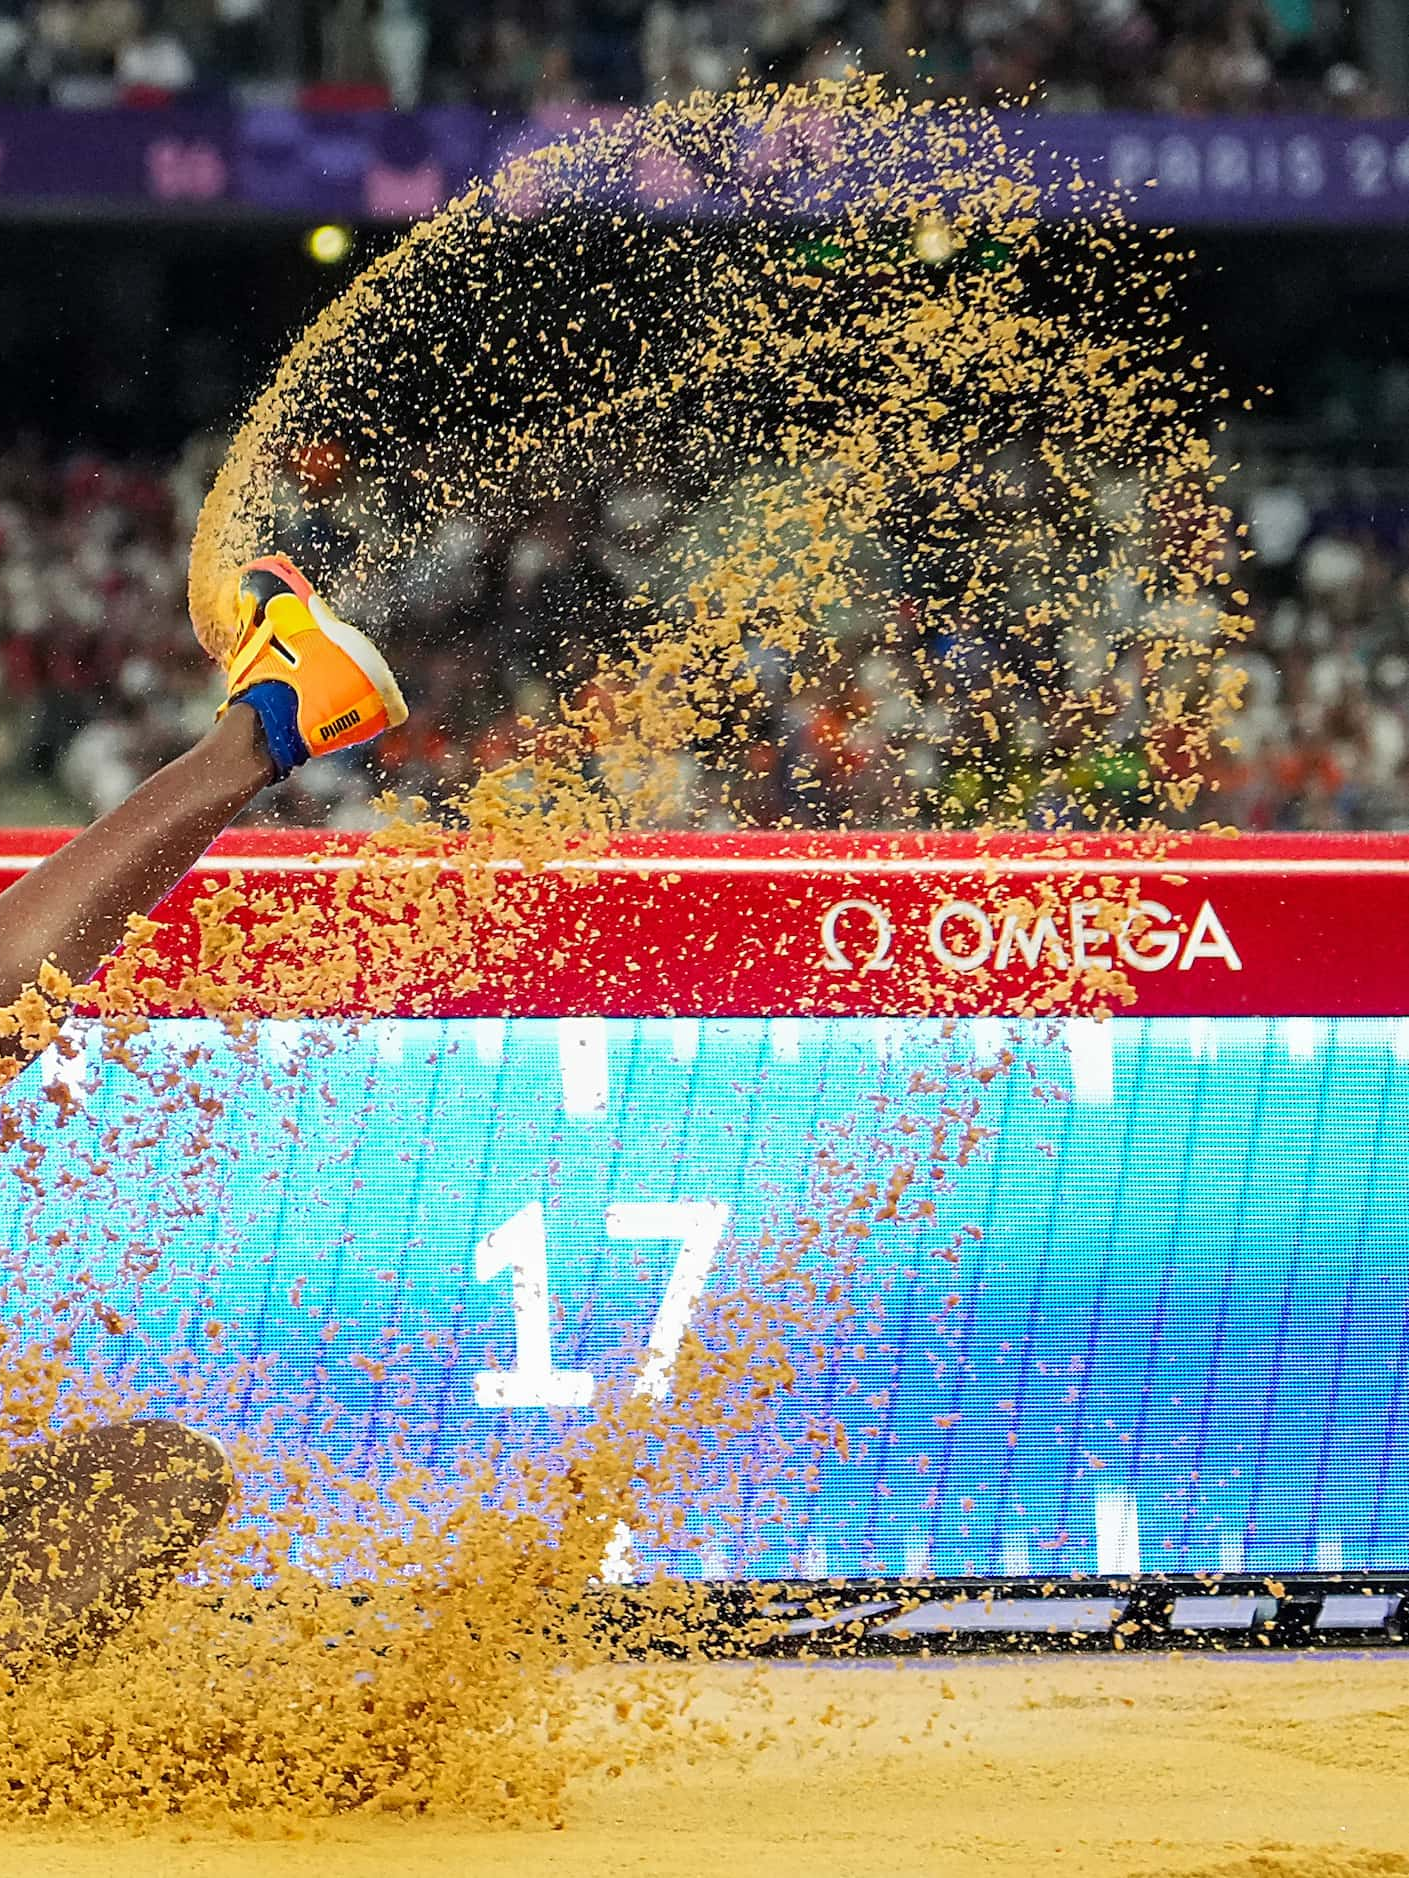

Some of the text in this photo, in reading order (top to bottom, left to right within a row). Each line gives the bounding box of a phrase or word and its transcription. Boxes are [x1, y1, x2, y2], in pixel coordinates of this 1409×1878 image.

[1109, 133, 1327, 197] PARIS
[319, 709, 361, 742] PUMA
[929, 898, 1243, 973] OMEGA
[474, 1201, 730, 1408] 17
